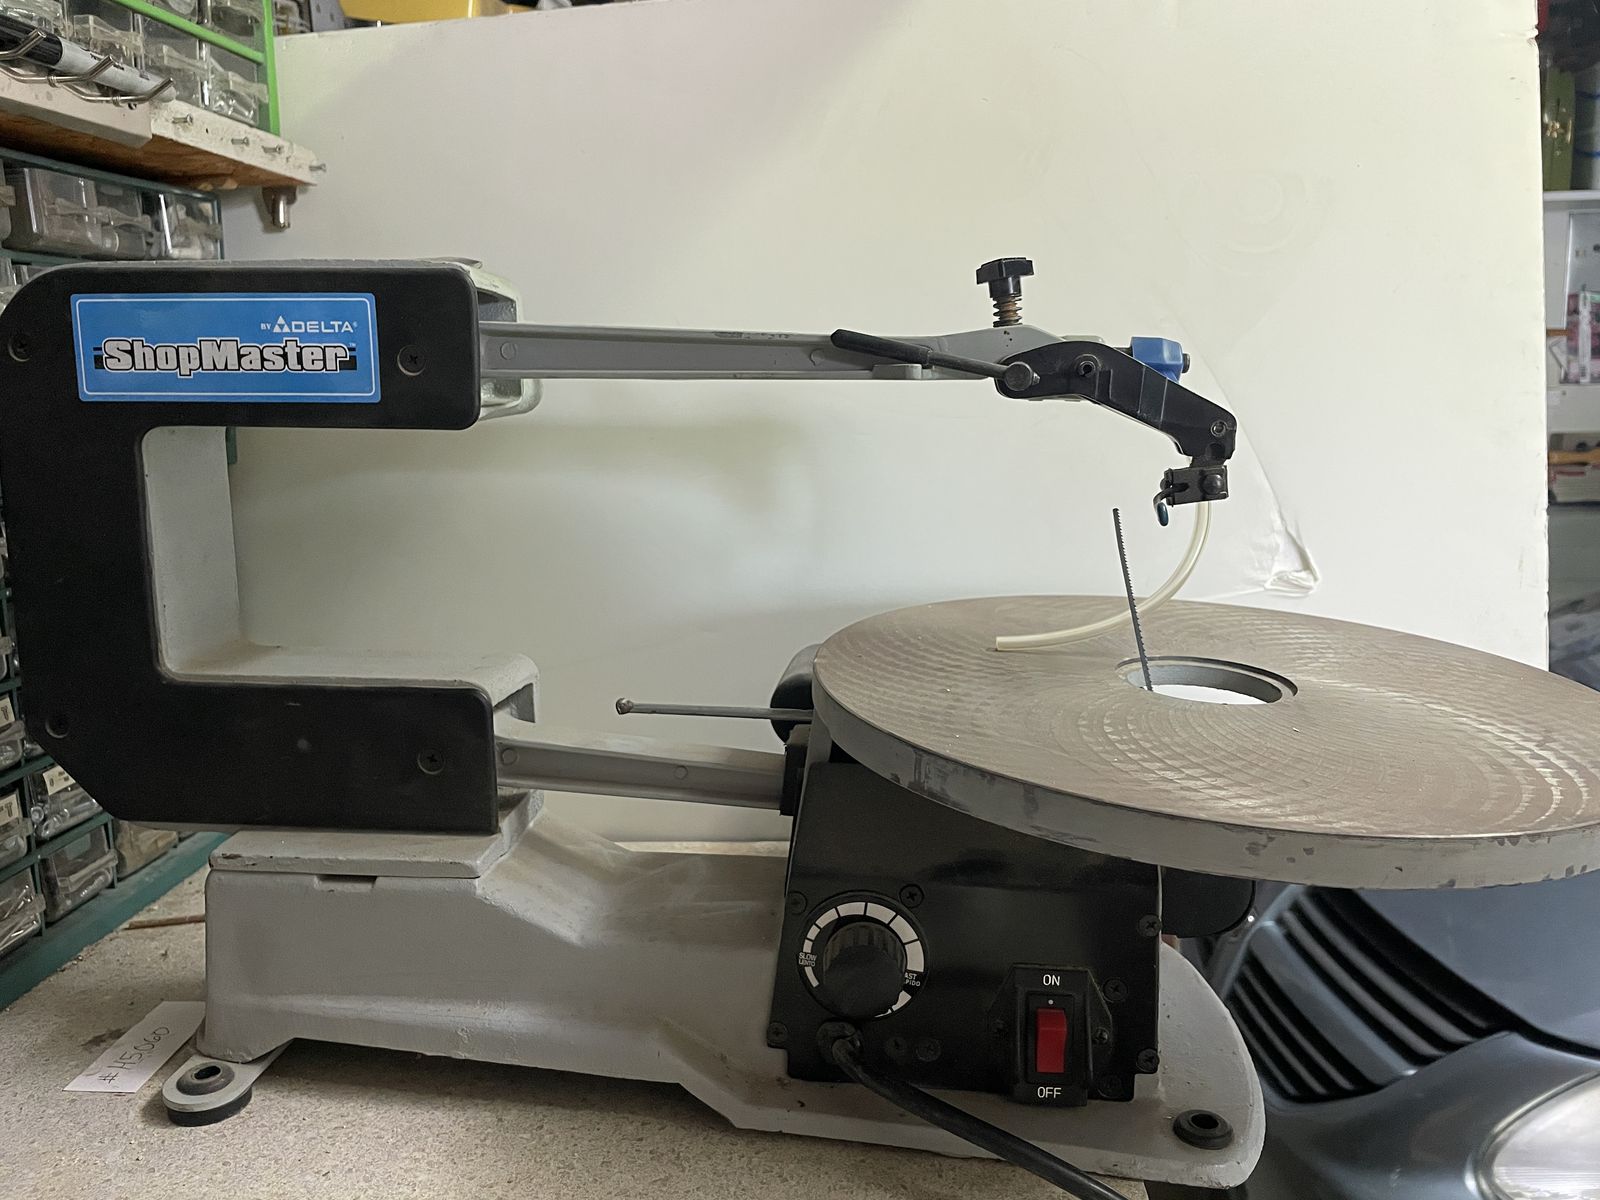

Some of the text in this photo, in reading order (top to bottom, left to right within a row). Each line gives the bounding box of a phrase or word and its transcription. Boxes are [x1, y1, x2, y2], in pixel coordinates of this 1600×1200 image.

[260, 322, 272, 331] BY
[101, 337, 351, 378] ShopMaster
[798, 952, 817, 961] SLOW
[798, 958, 816, 967] LENTO
[1042, 974, 1061, 987] ON
[1037, 1086, 1062, 1099] OFF
